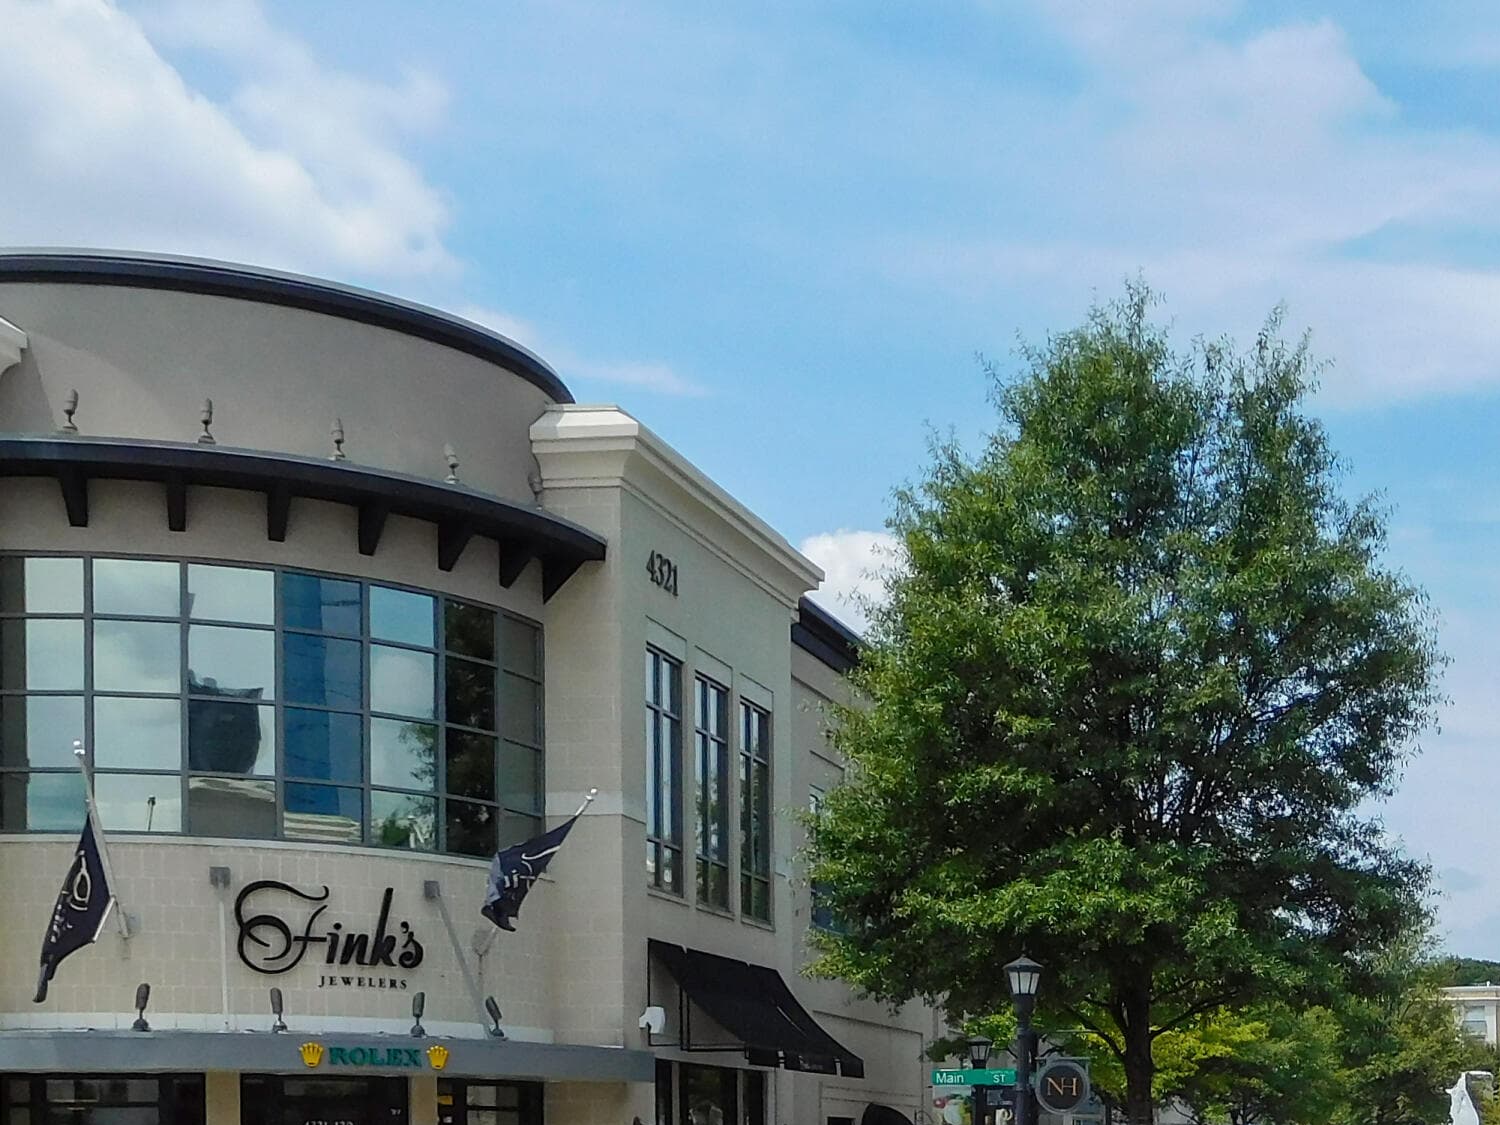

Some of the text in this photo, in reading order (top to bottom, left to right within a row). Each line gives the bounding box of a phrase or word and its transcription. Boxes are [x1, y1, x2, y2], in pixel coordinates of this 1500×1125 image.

[646, 549, 679, 597] 4321
[234, 880, 424, 975] Fink's
[318, 975, 408, 990] JEWELERS
[328, 1047, 423, 1067] ROLEX
[935, 1072, 965, 1084] Main
[1046, 1076, 1078, 1097] NH
